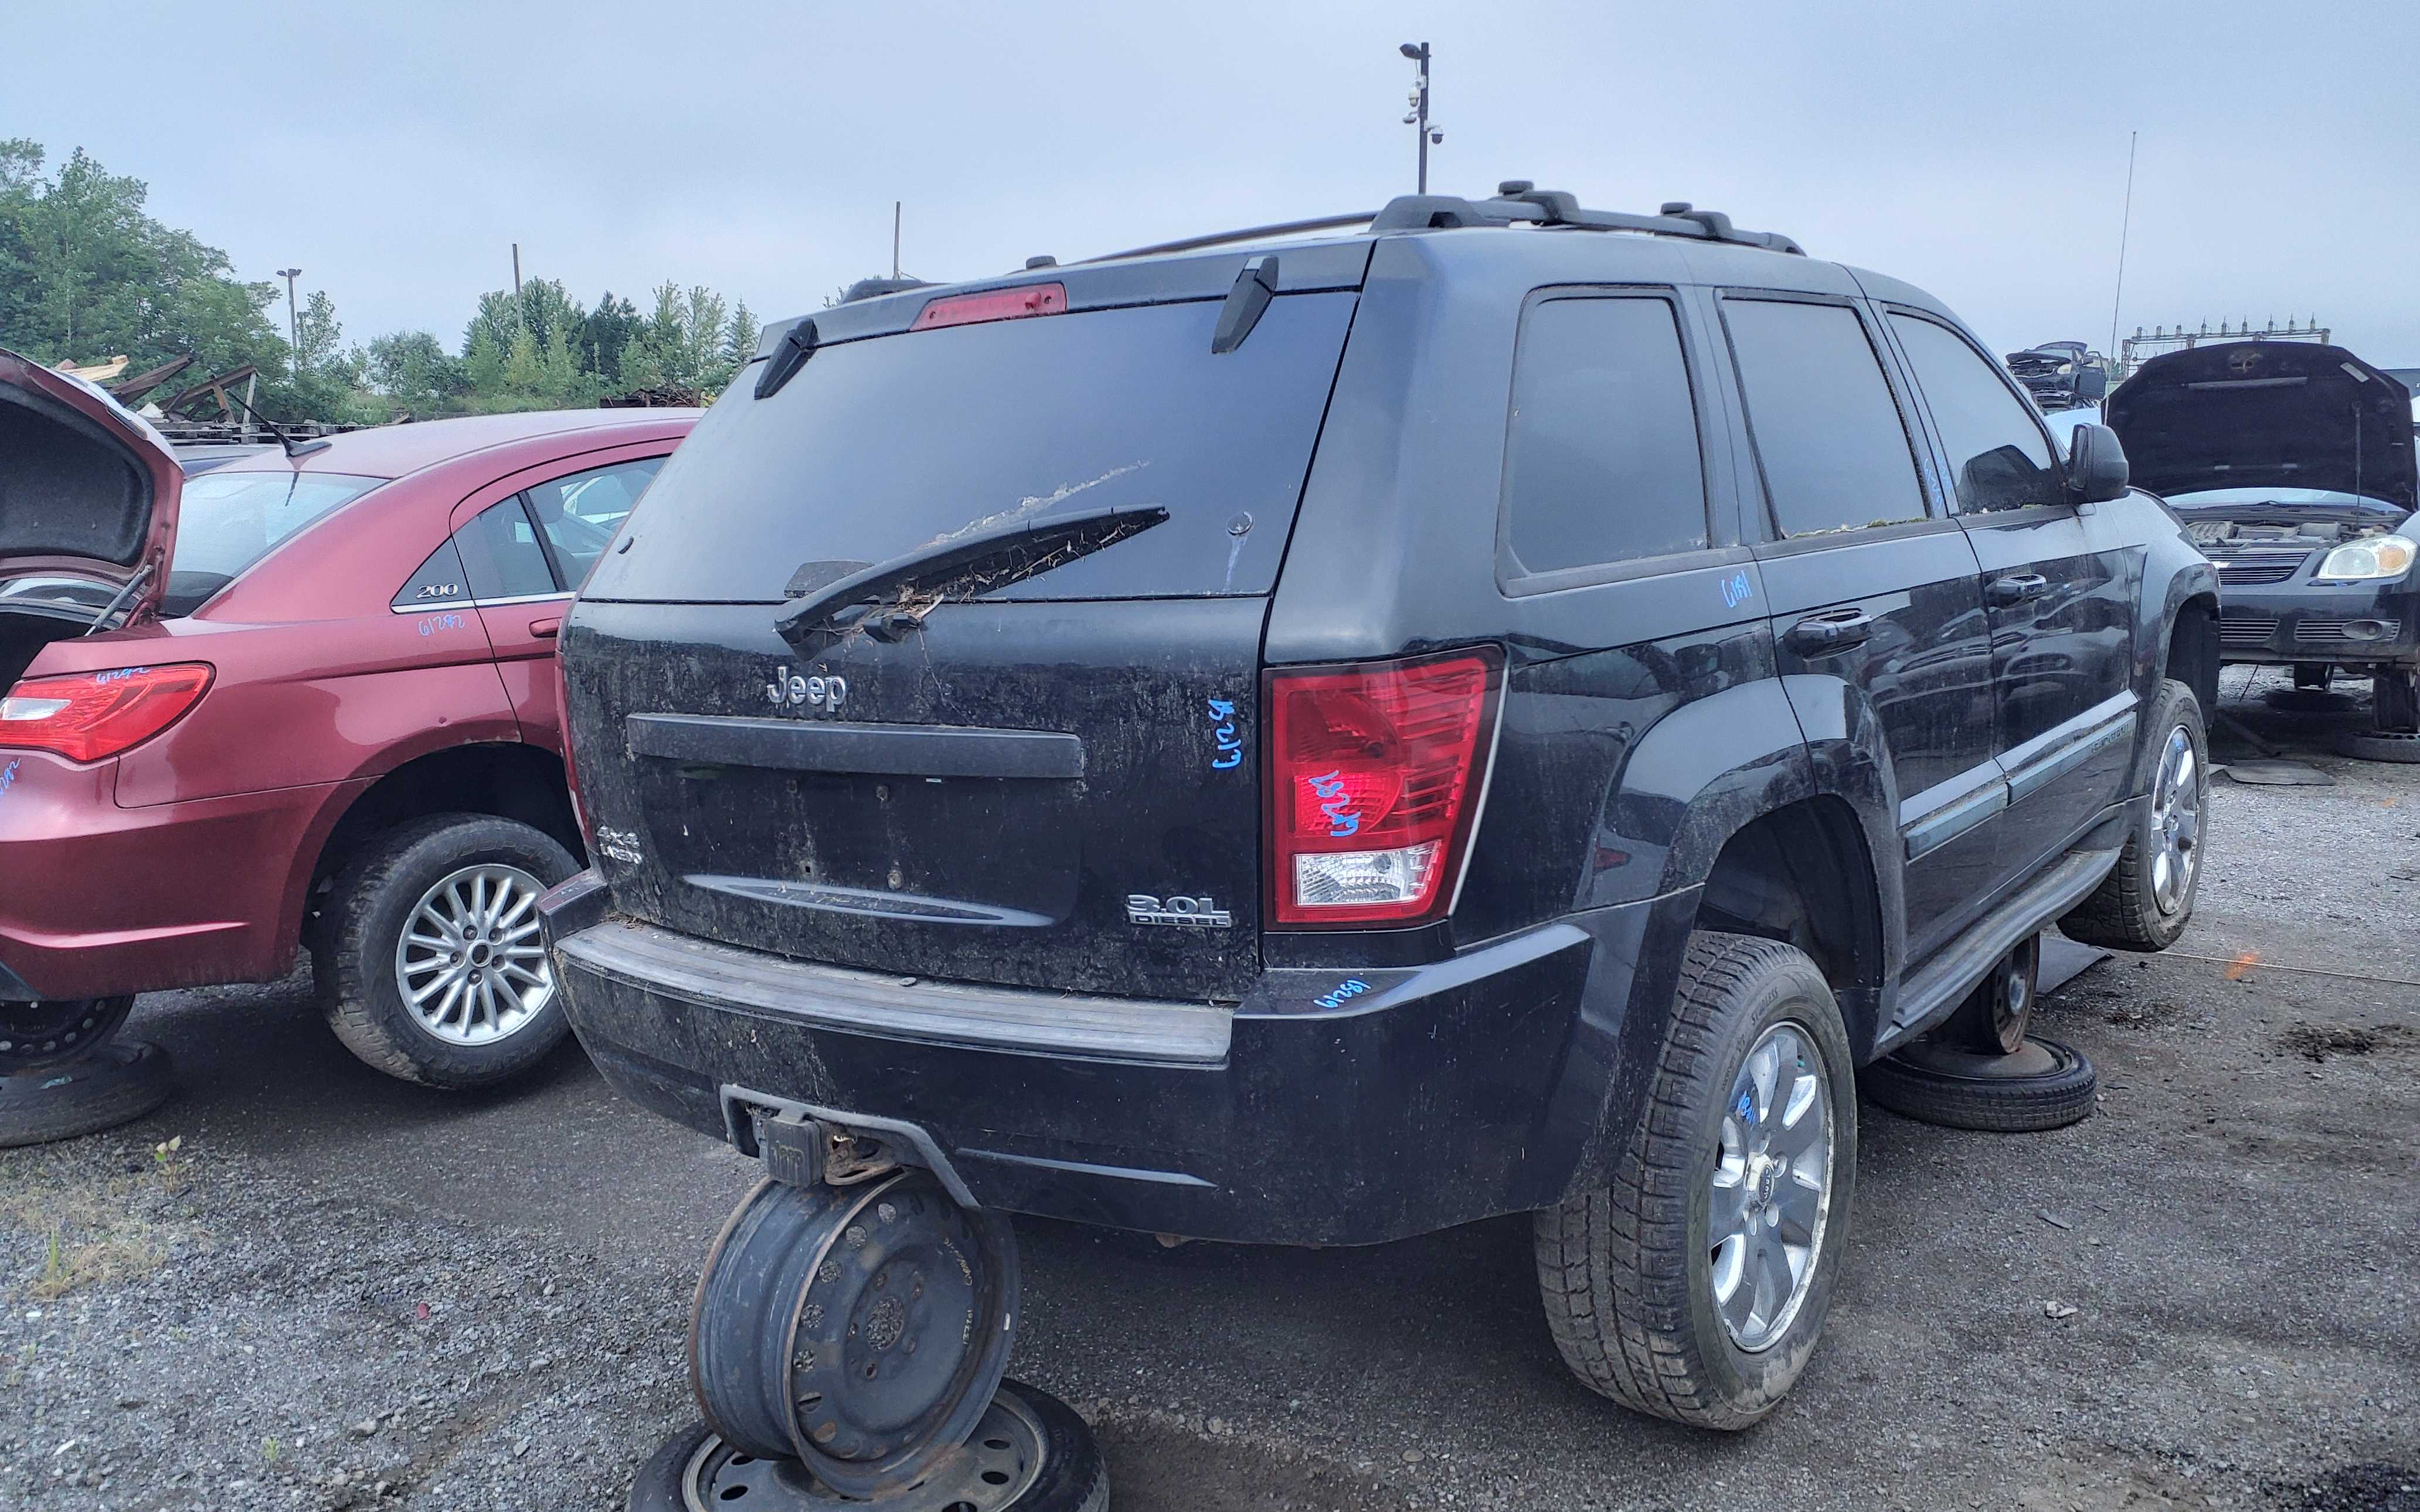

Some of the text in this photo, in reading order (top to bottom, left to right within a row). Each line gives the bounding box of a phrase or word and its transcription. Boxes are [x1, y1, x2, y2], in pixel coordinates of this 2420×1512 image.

[417, 583, 458, 598] 200
[766, 666, 847, 713] Jeep
[1126, 894, 1230, 915] 3.0L
[1134, 914, 1228, 926] DIESEL
